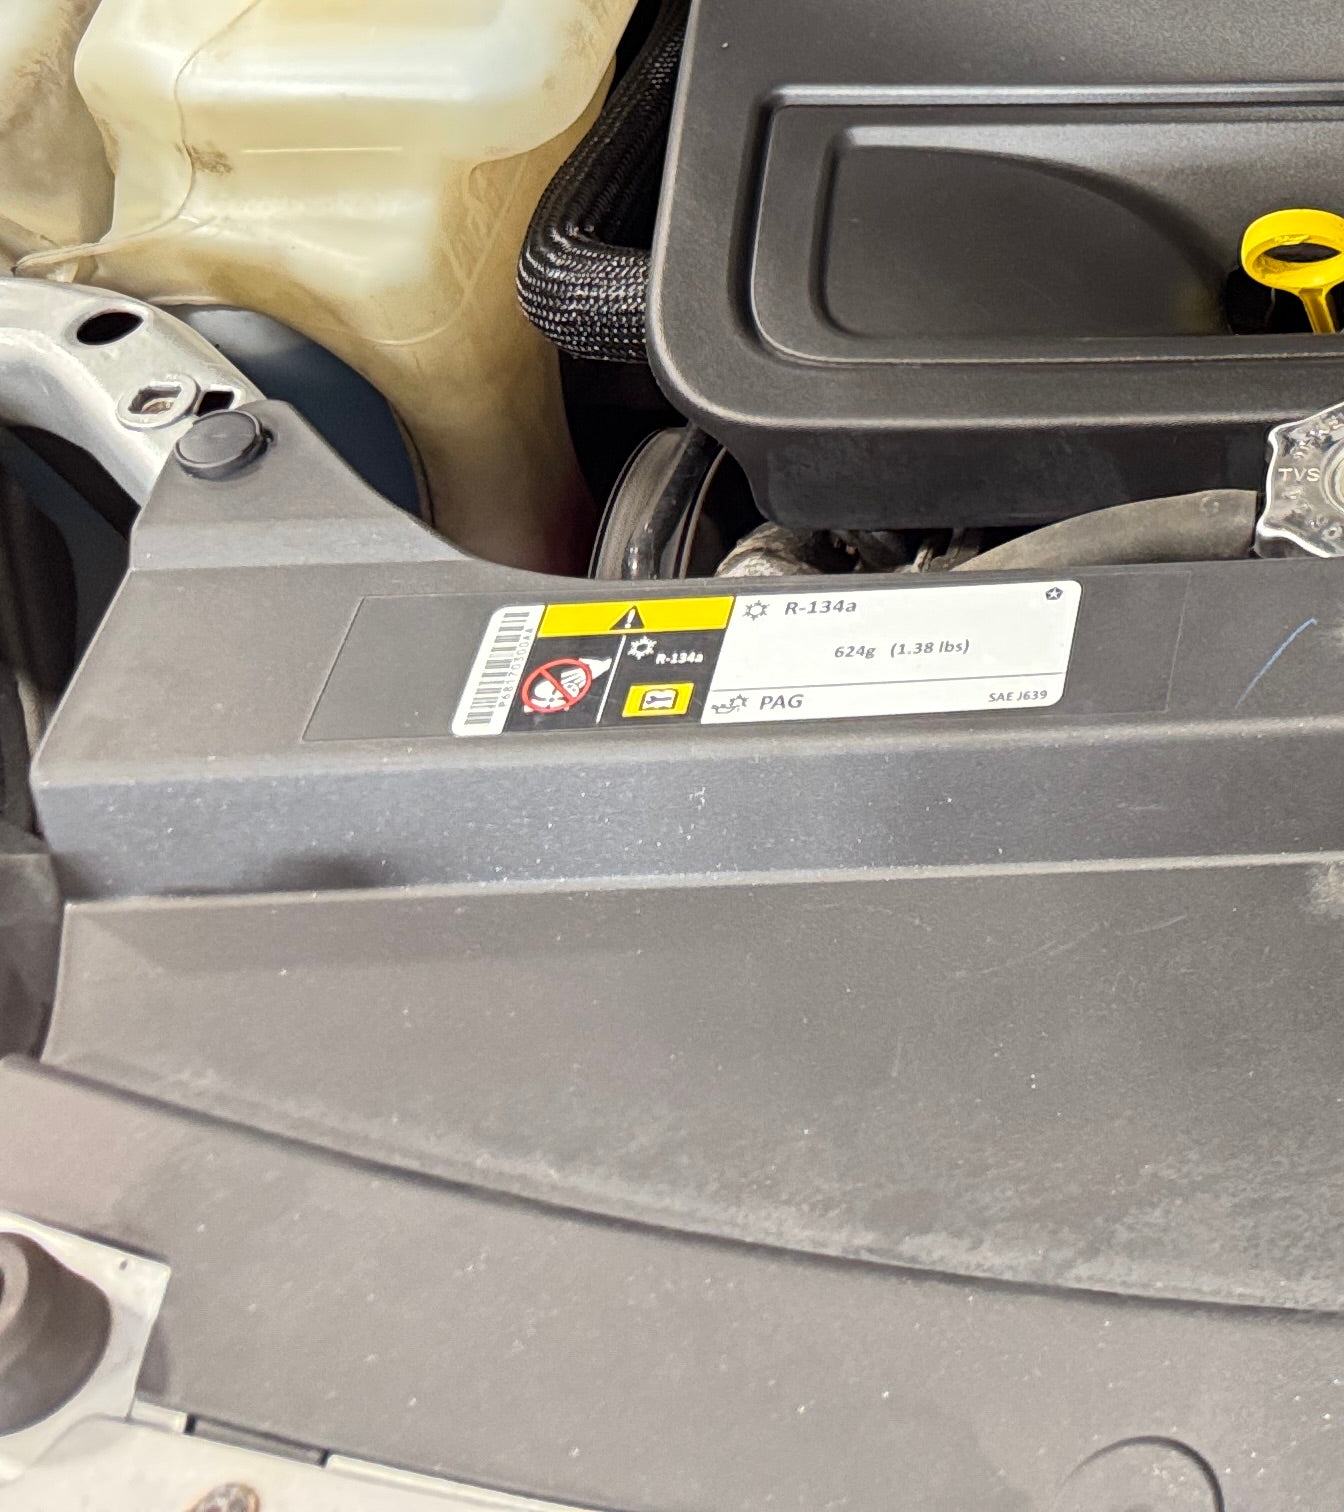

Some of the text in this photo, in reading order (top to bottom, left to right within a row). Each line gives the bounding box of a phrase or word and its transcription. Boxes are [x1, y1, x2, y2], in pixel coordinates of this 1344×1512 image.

[1278, 467, 1321, 482] TVS
[784, 600, 858, 616] R-134a
[834, 639, 970, 659] 624g (1.38 lbs)
[655, 652, 704, 665] R-134a
[759, 694, 805, 710] PAG
[988, 689, 1048, 703] SAE J639
